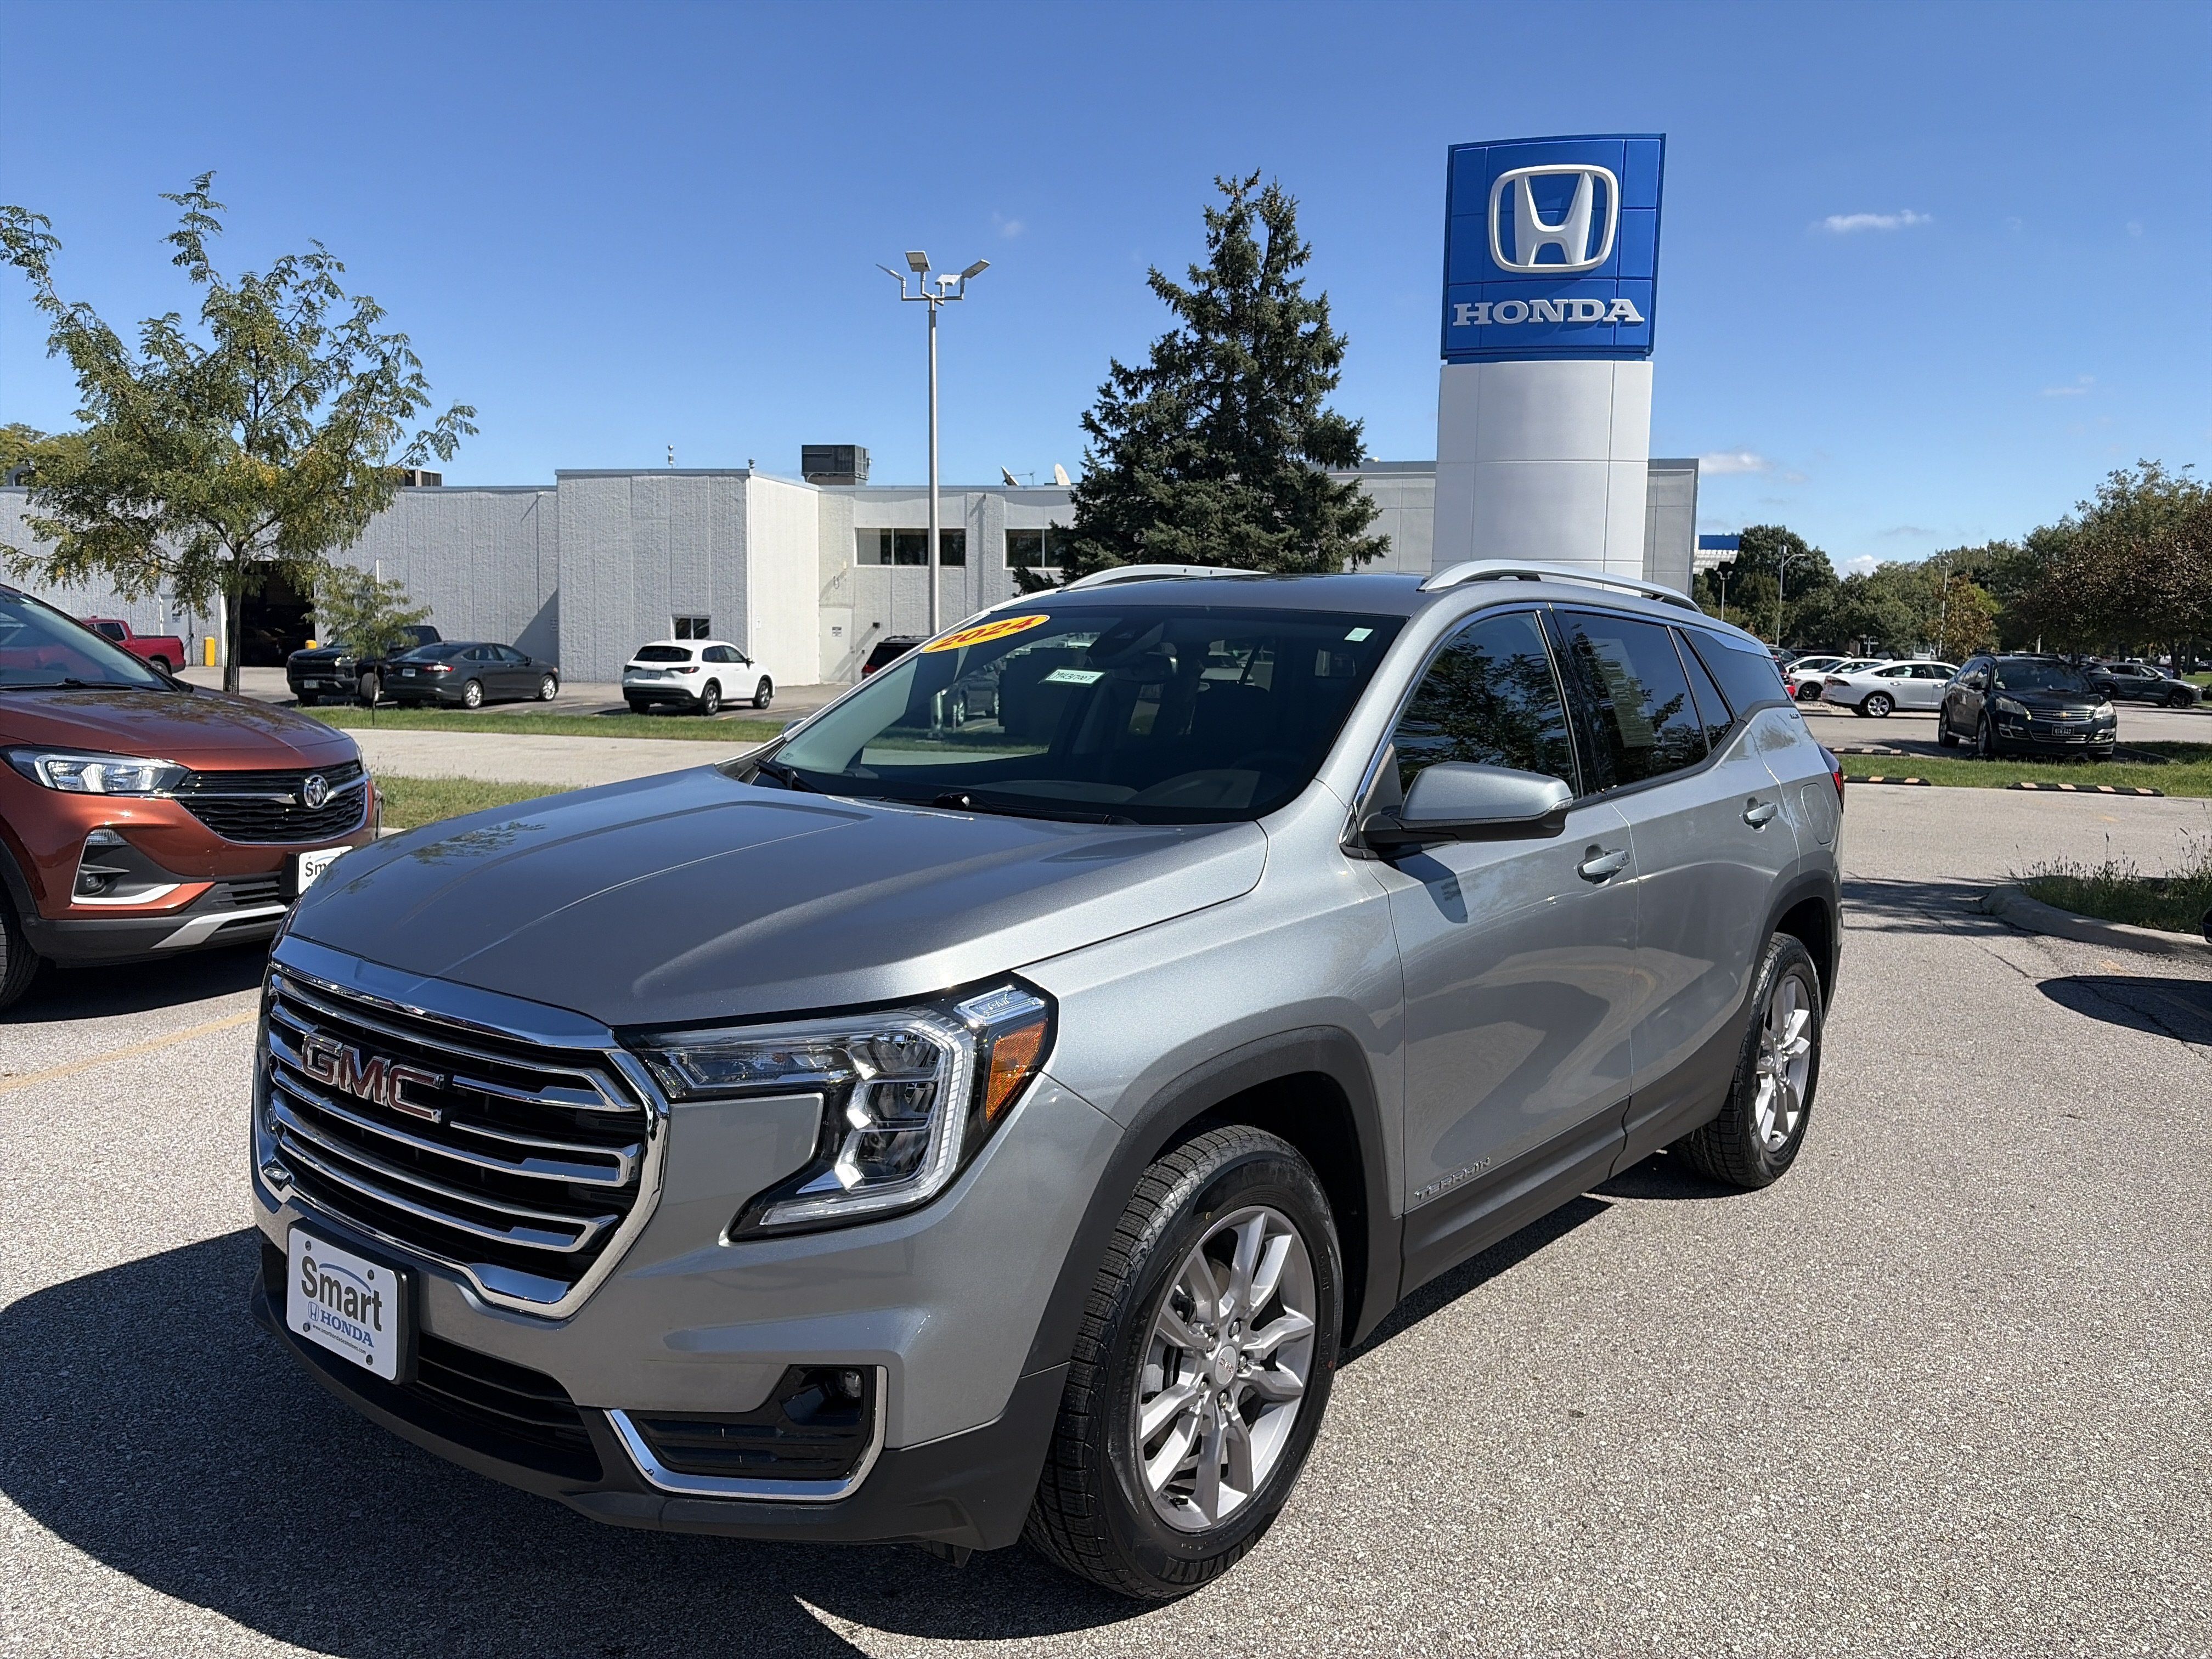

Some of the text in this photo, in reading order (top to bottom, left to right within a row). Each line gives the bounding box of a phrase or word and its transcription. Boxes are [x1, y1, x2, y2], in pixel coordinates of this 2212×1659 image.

[1453, 299, 1645, 326] HONDA
[929, 617, 1040, 651] 2024
[302, 1033, 444, 1124] GMC
[302, 1256, 382, 1332] Smart
[320, 1309, 374, 1348] HONDA
